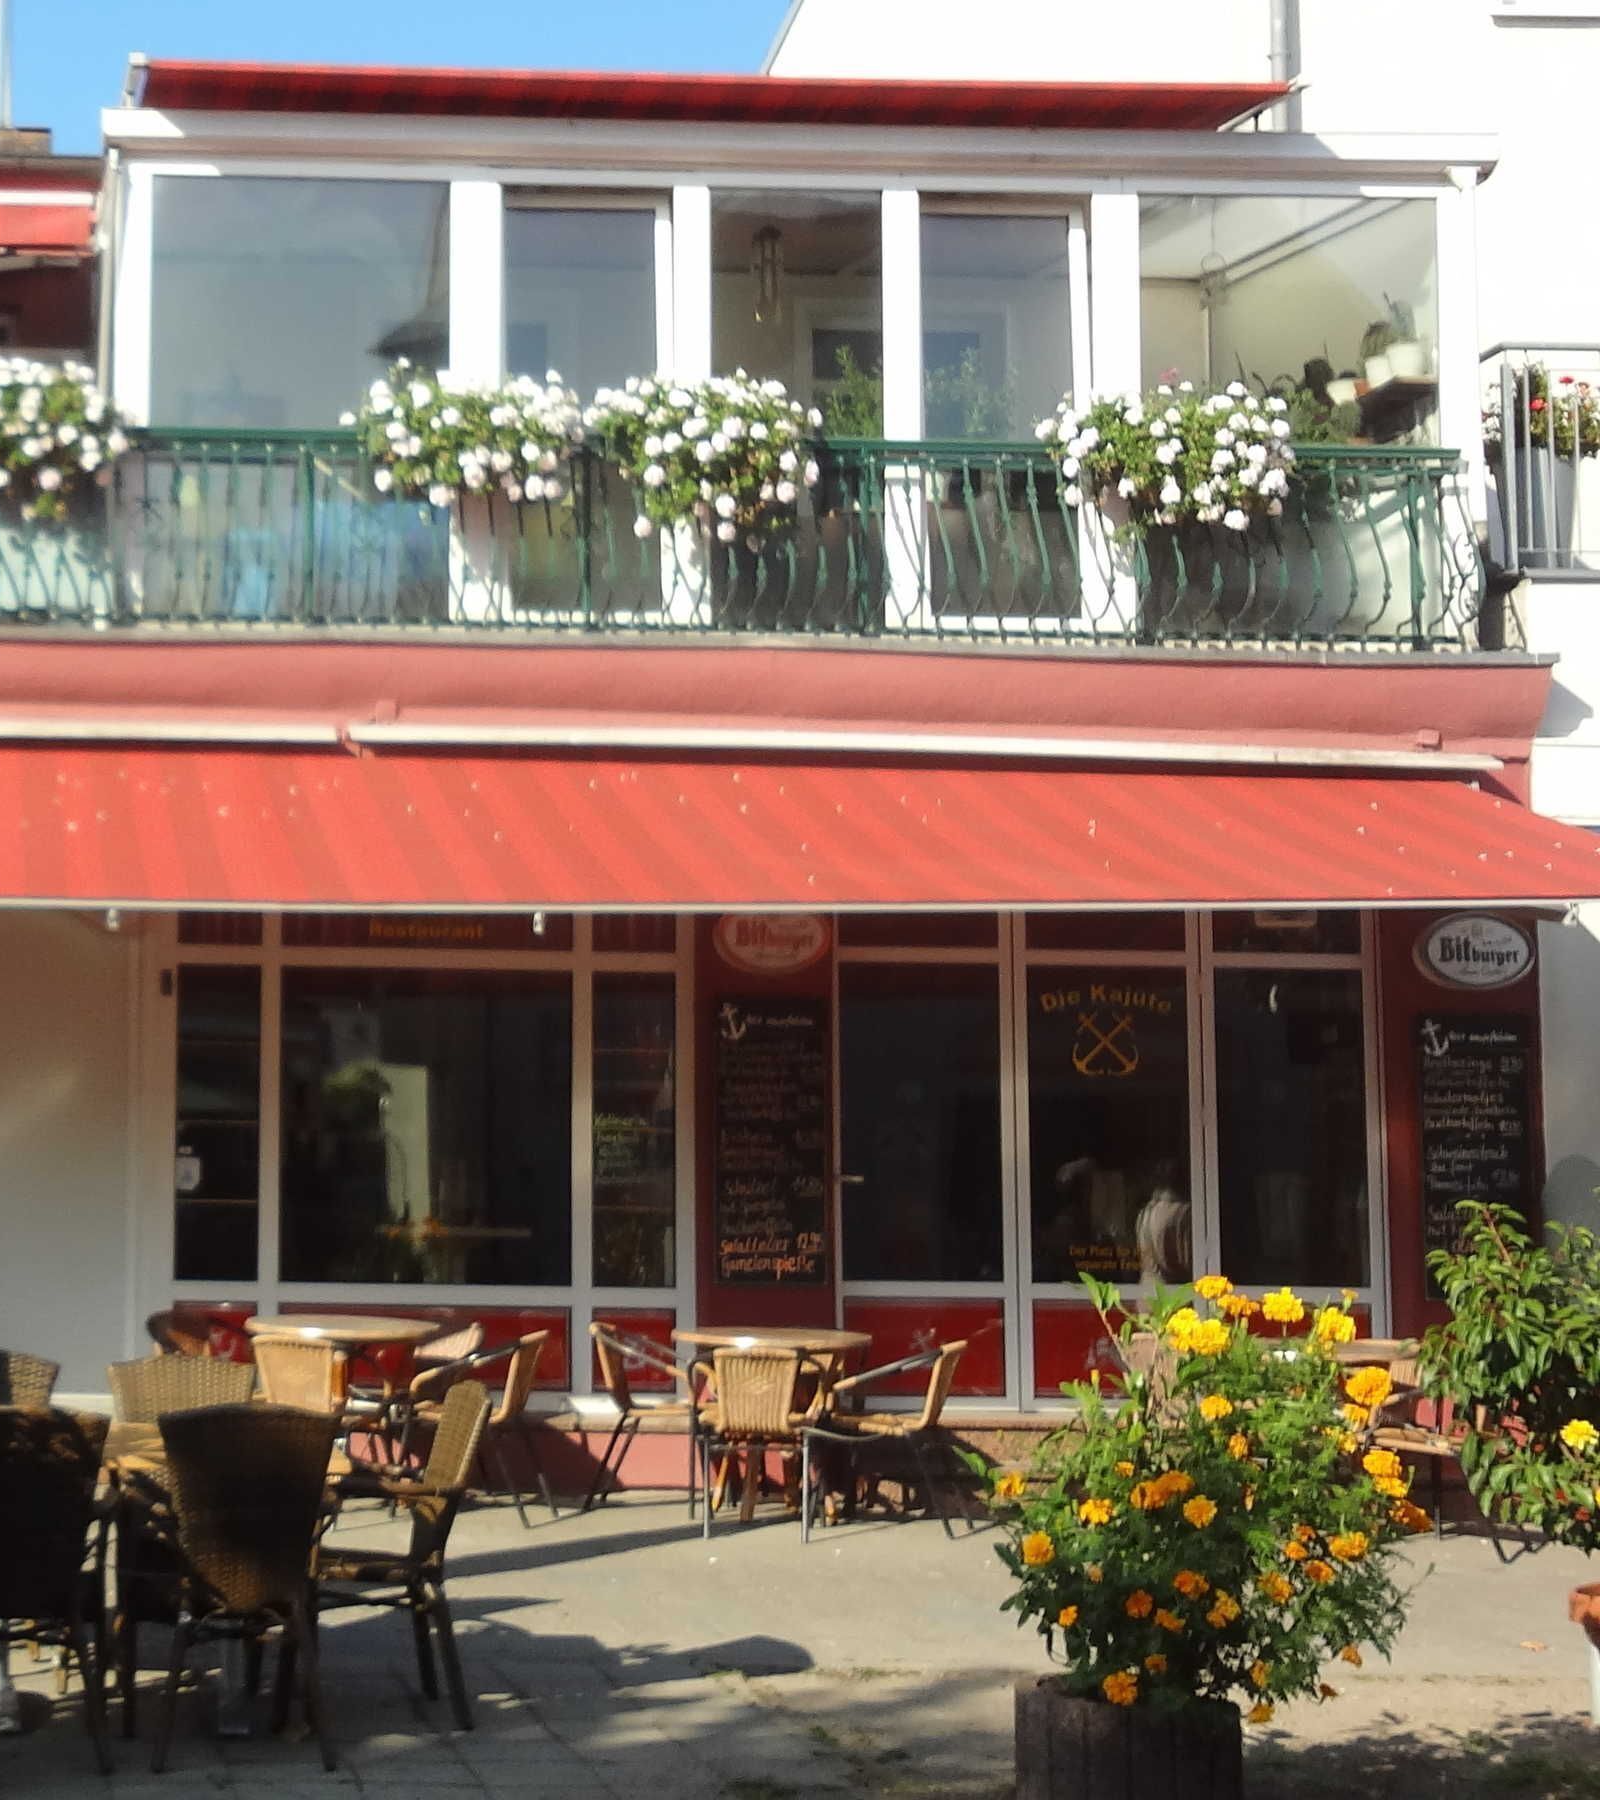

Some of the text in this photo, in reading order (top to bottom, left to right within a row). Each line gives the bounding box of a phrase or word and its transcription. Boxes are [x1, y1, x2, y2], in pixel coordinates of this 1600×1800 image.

[369, 918, 485, 938] Restaurant
[1438, 935, 1519, 966] Bitburger
[1040, 988, 1081, 1013] Die
